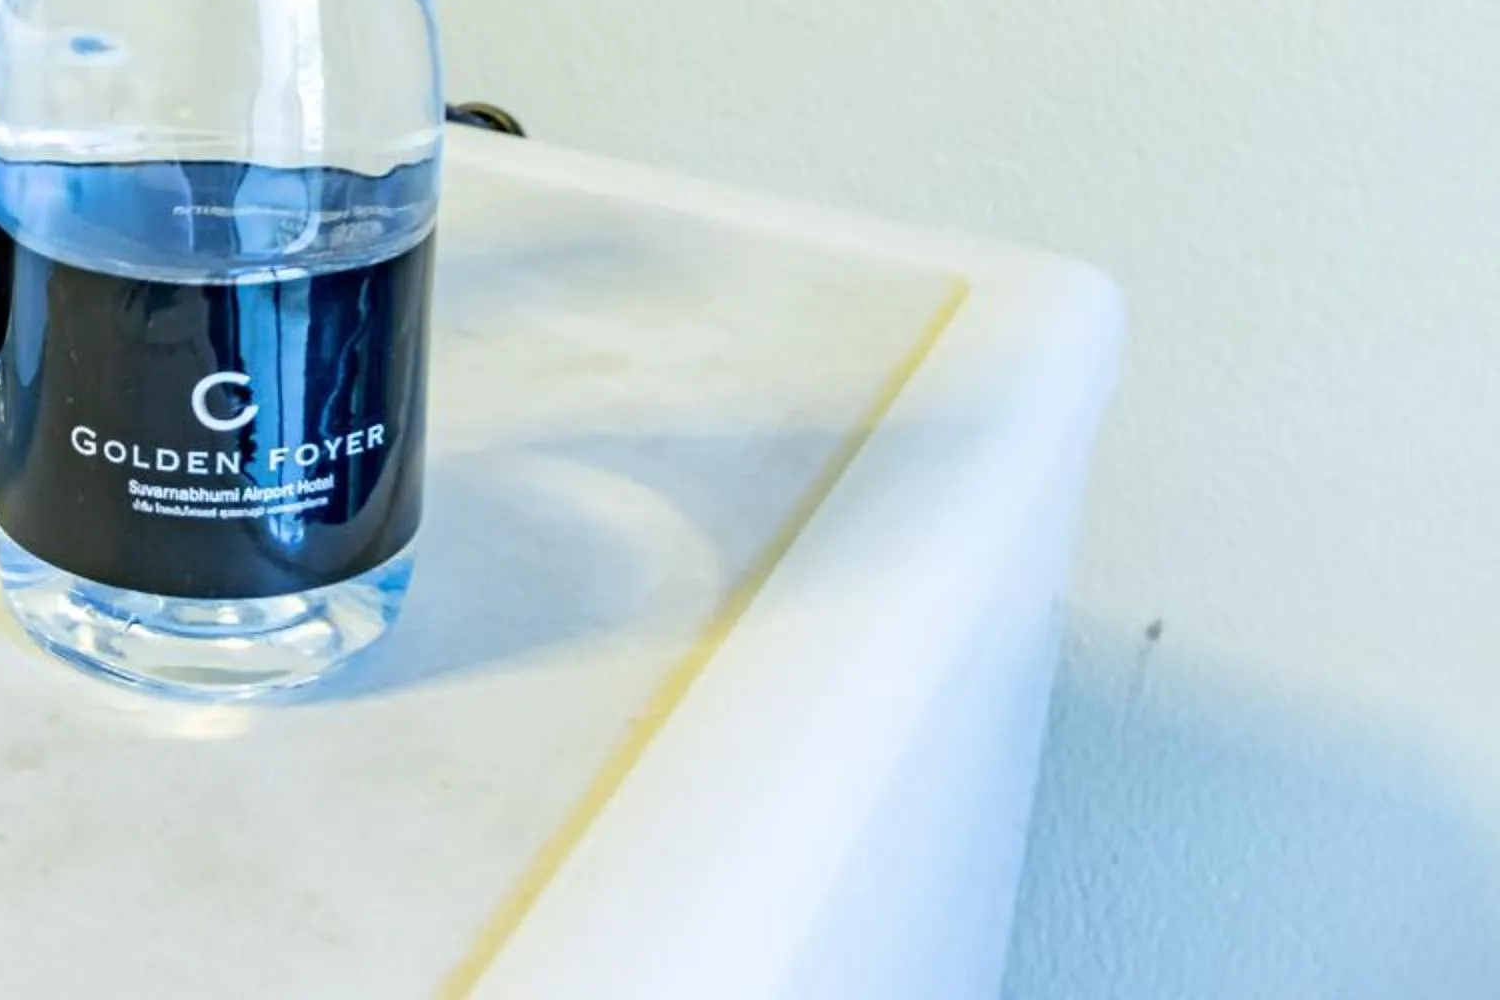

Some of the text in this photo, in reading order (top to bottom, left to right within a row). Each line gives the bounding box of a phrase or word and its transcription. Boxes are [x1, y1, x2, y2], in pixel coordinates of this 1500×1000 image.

[70, 423, 385, 475] GOLDEN FOYER
[127, 472, 335, 503] Suvarnabhumi Airport Hotel
